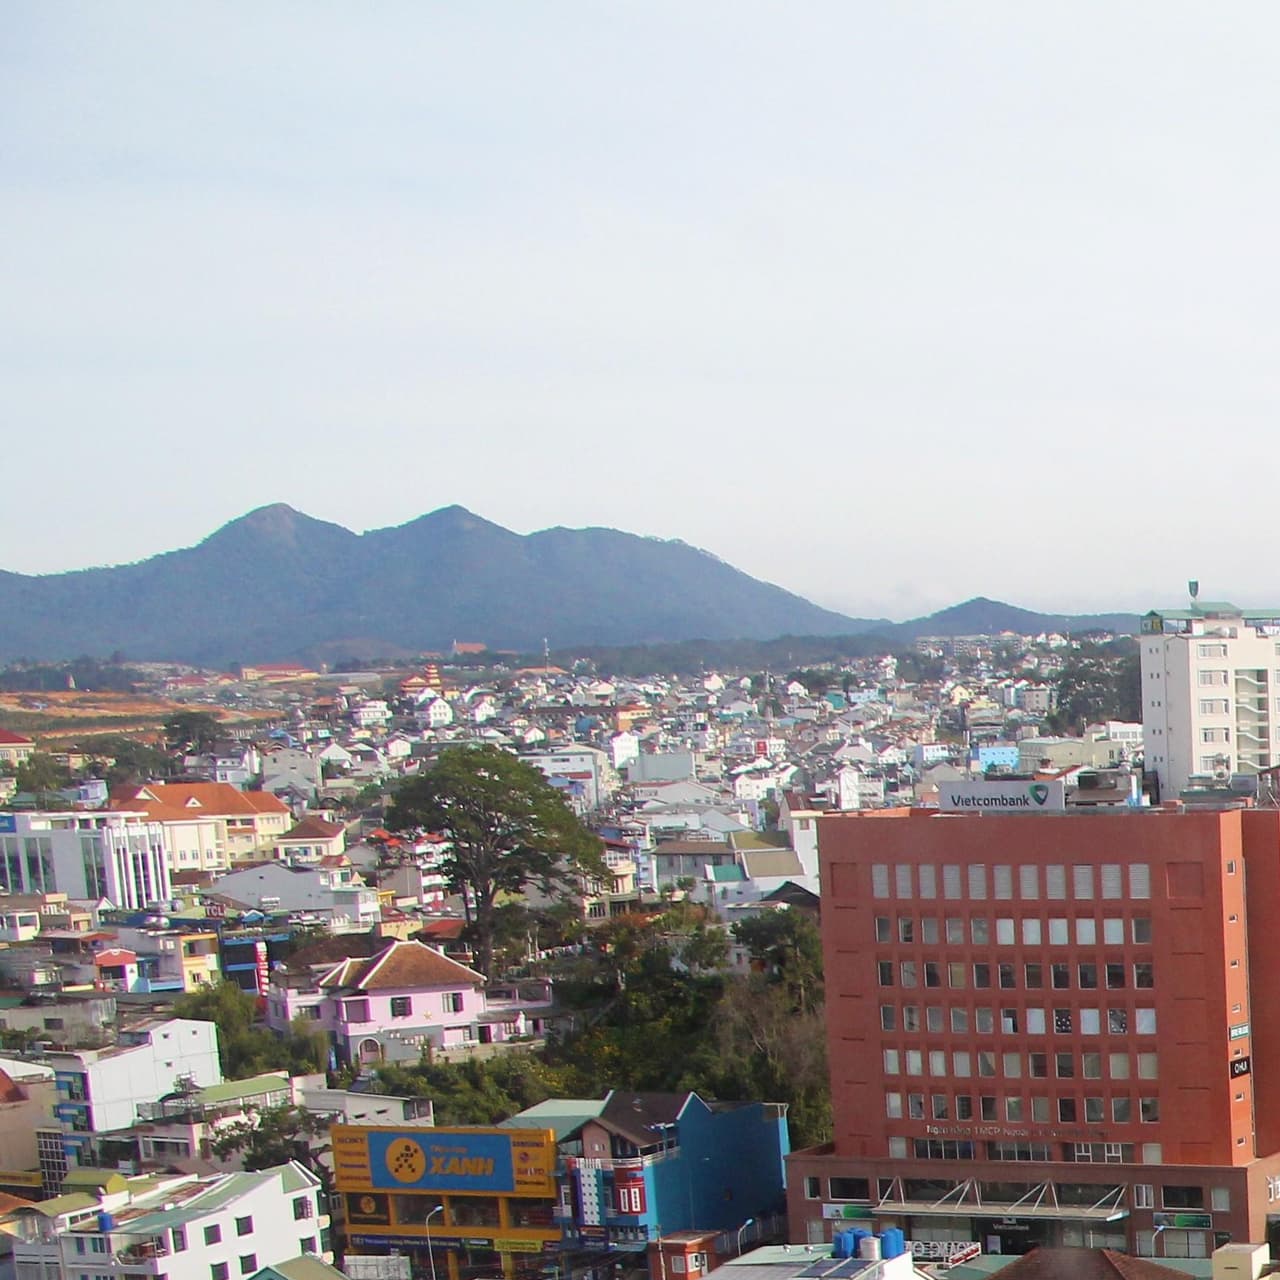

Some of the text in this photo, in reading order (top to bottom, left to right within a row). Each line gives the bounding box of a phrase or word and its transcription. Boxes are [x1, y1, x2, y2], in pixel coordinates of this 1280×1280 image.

[951, 794, 1029, 806] Vietcombank
[206, 905, 224, 916] TCL
[429, 1156, 494, 1176] XANH
